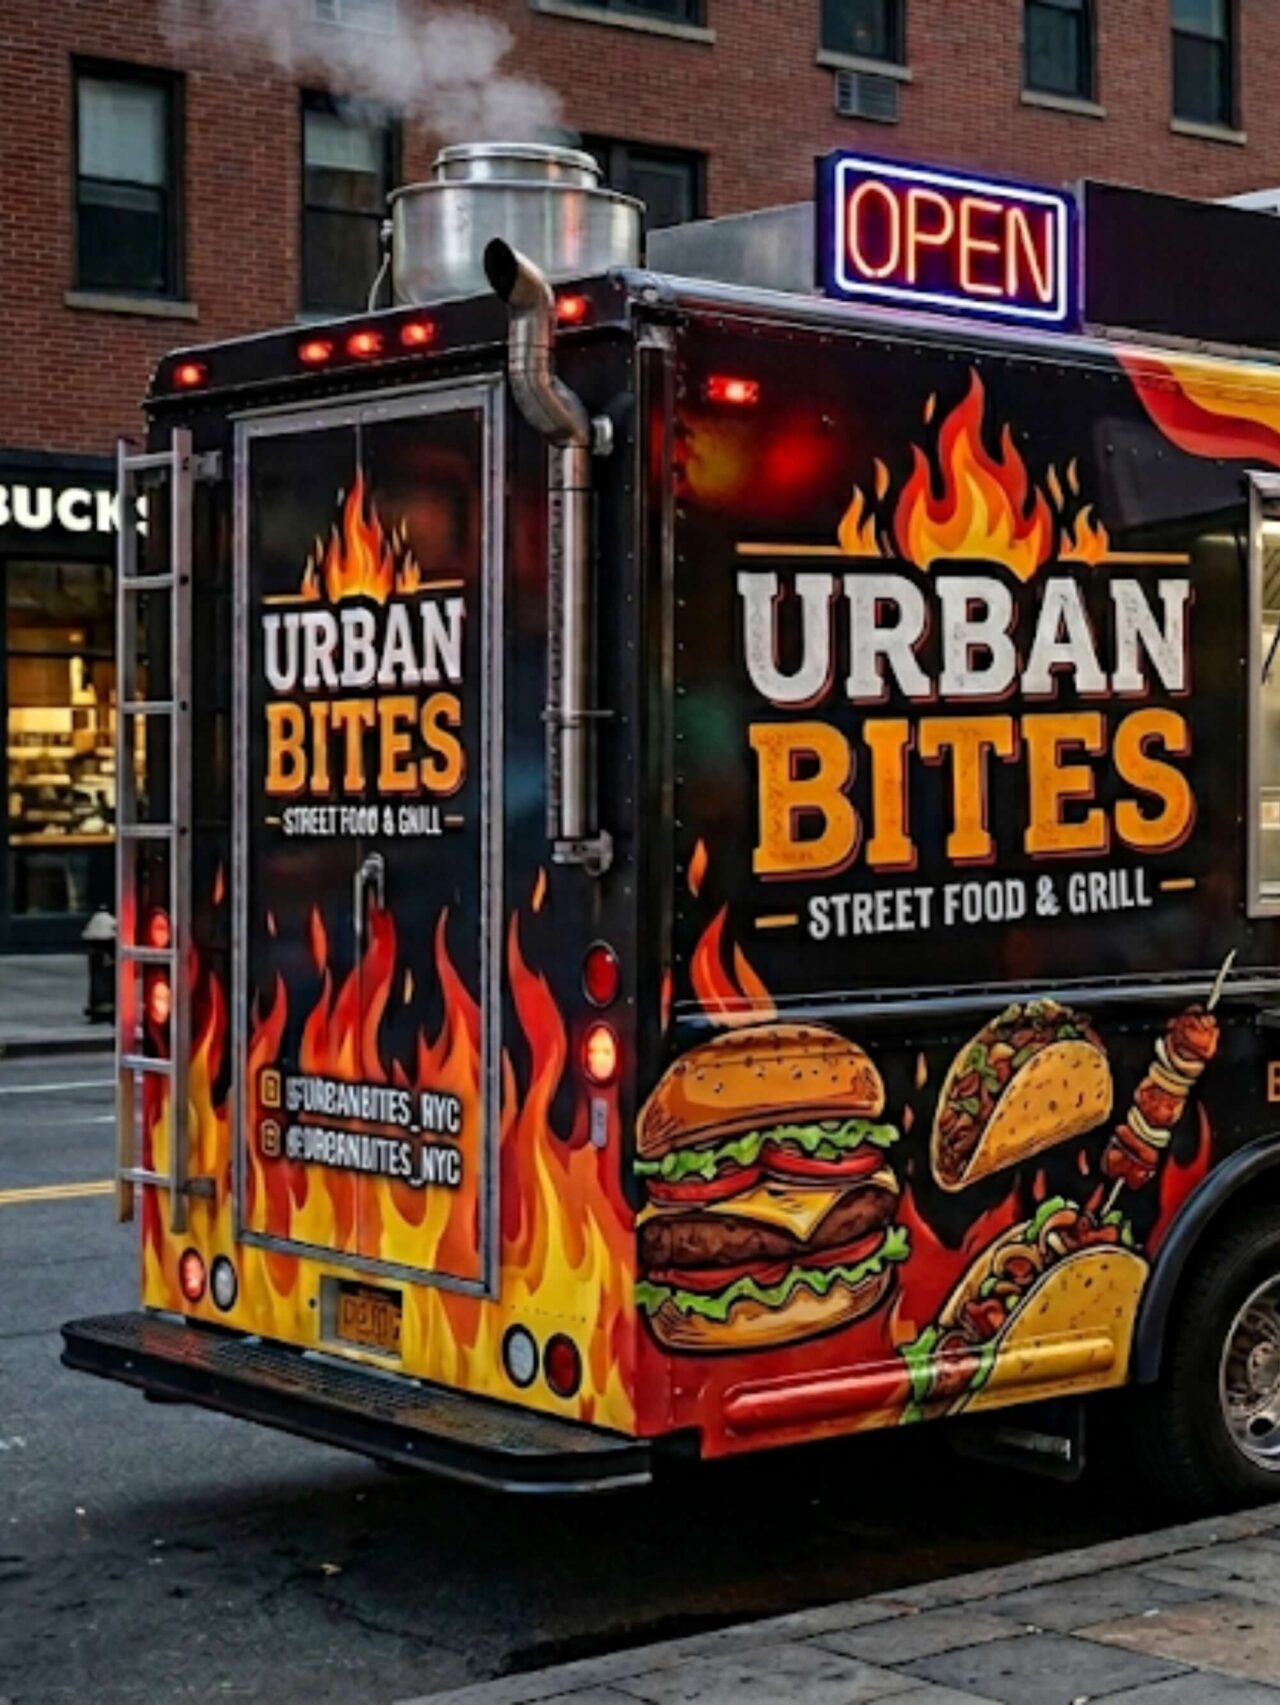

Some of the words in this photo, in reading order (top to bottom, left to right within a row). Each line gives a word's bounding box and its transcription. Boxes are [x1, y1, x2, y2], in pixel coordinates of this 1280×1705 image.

[848, 180, 1053, 302] OPEN
[262, 598, 465, 693] URBAN
[737, 571, 1195, 709] URBAN
[265, 692, 465, 796] BITES
[749, 708, 1197, 880] BITES
[808, 886, 934, 940] STREET
[944, 880, 1026, 926] FOOD
[1035, 874, 1061, 917] &
[1068, 867, 1153, 914] GRILL
